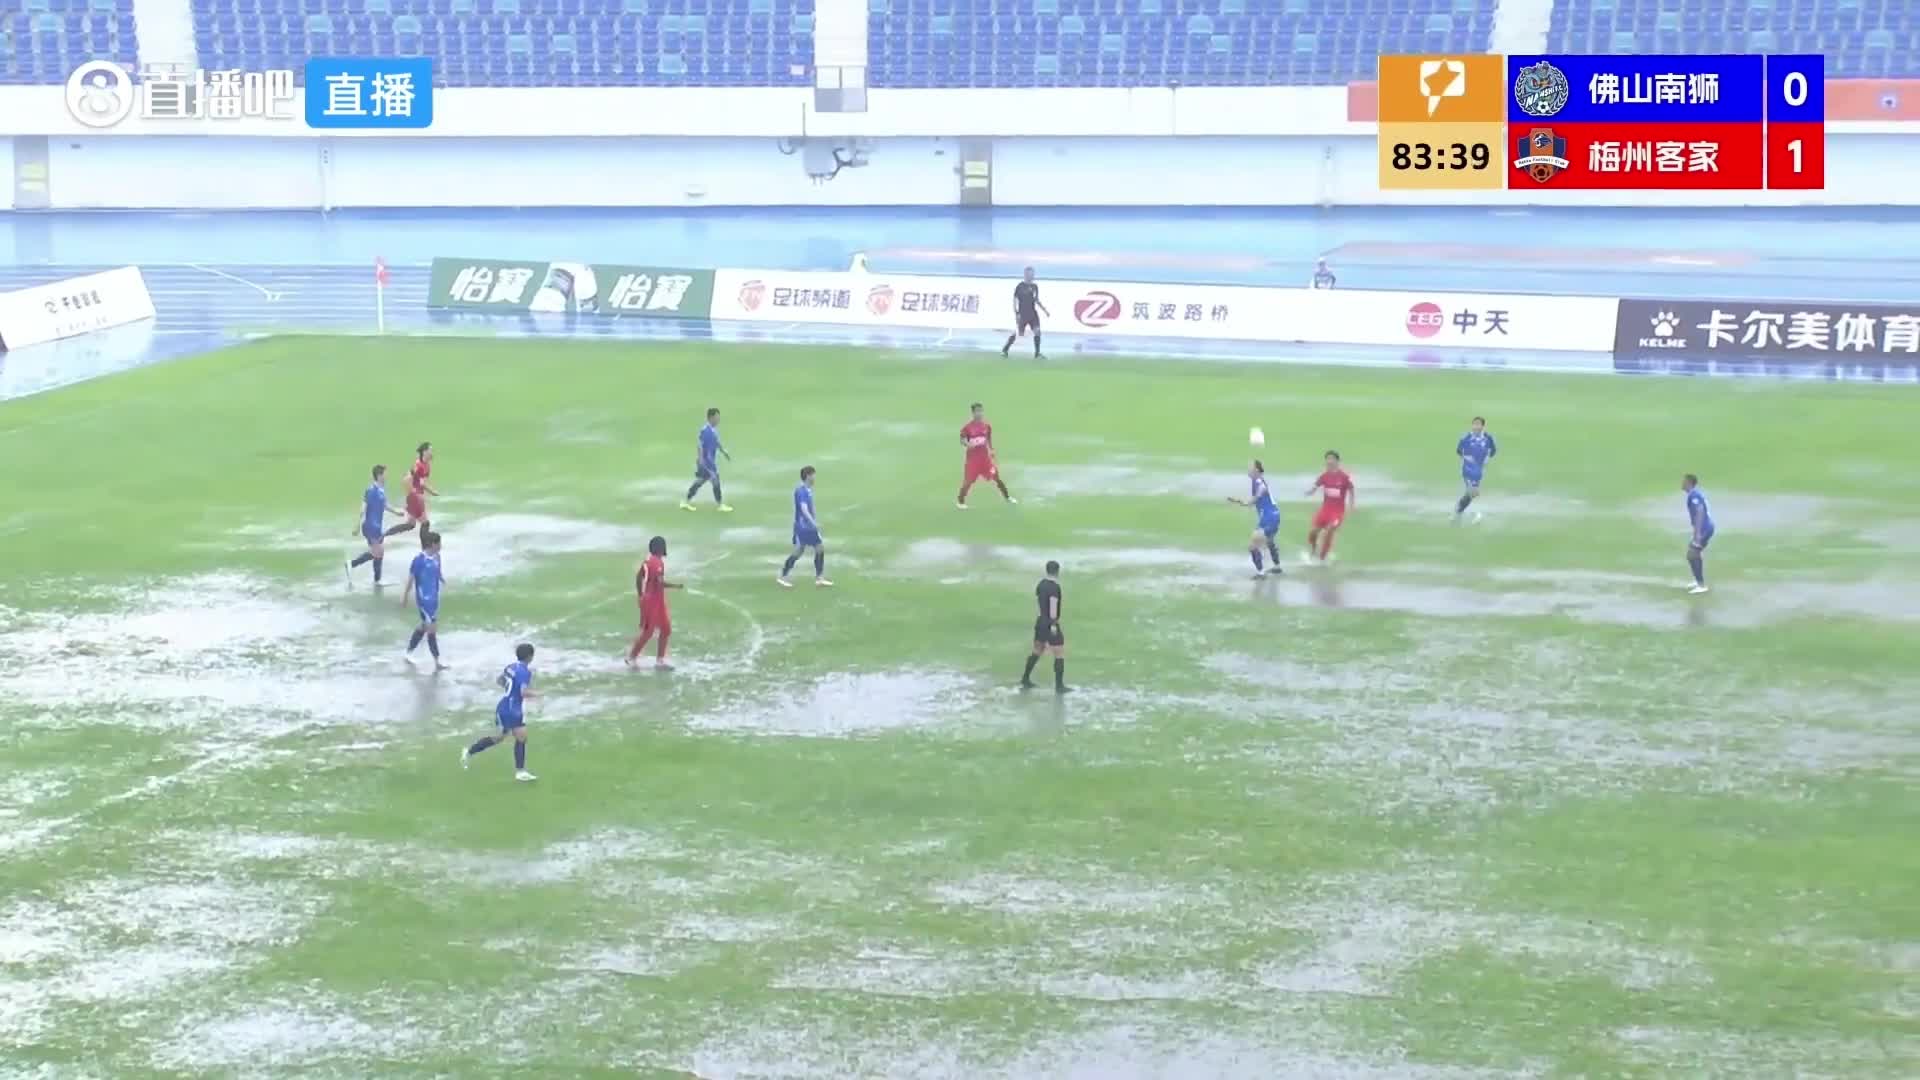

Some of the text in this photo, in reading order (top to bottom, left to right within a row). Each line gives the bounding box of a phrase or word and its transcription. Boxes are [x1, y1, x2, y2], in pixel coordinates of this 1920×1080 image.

[1453, 308, 1509, 335] 中天
[1696, 309, 1920, 352] 卡尔美体育
[1639, 338, 1688, 348] KELME
